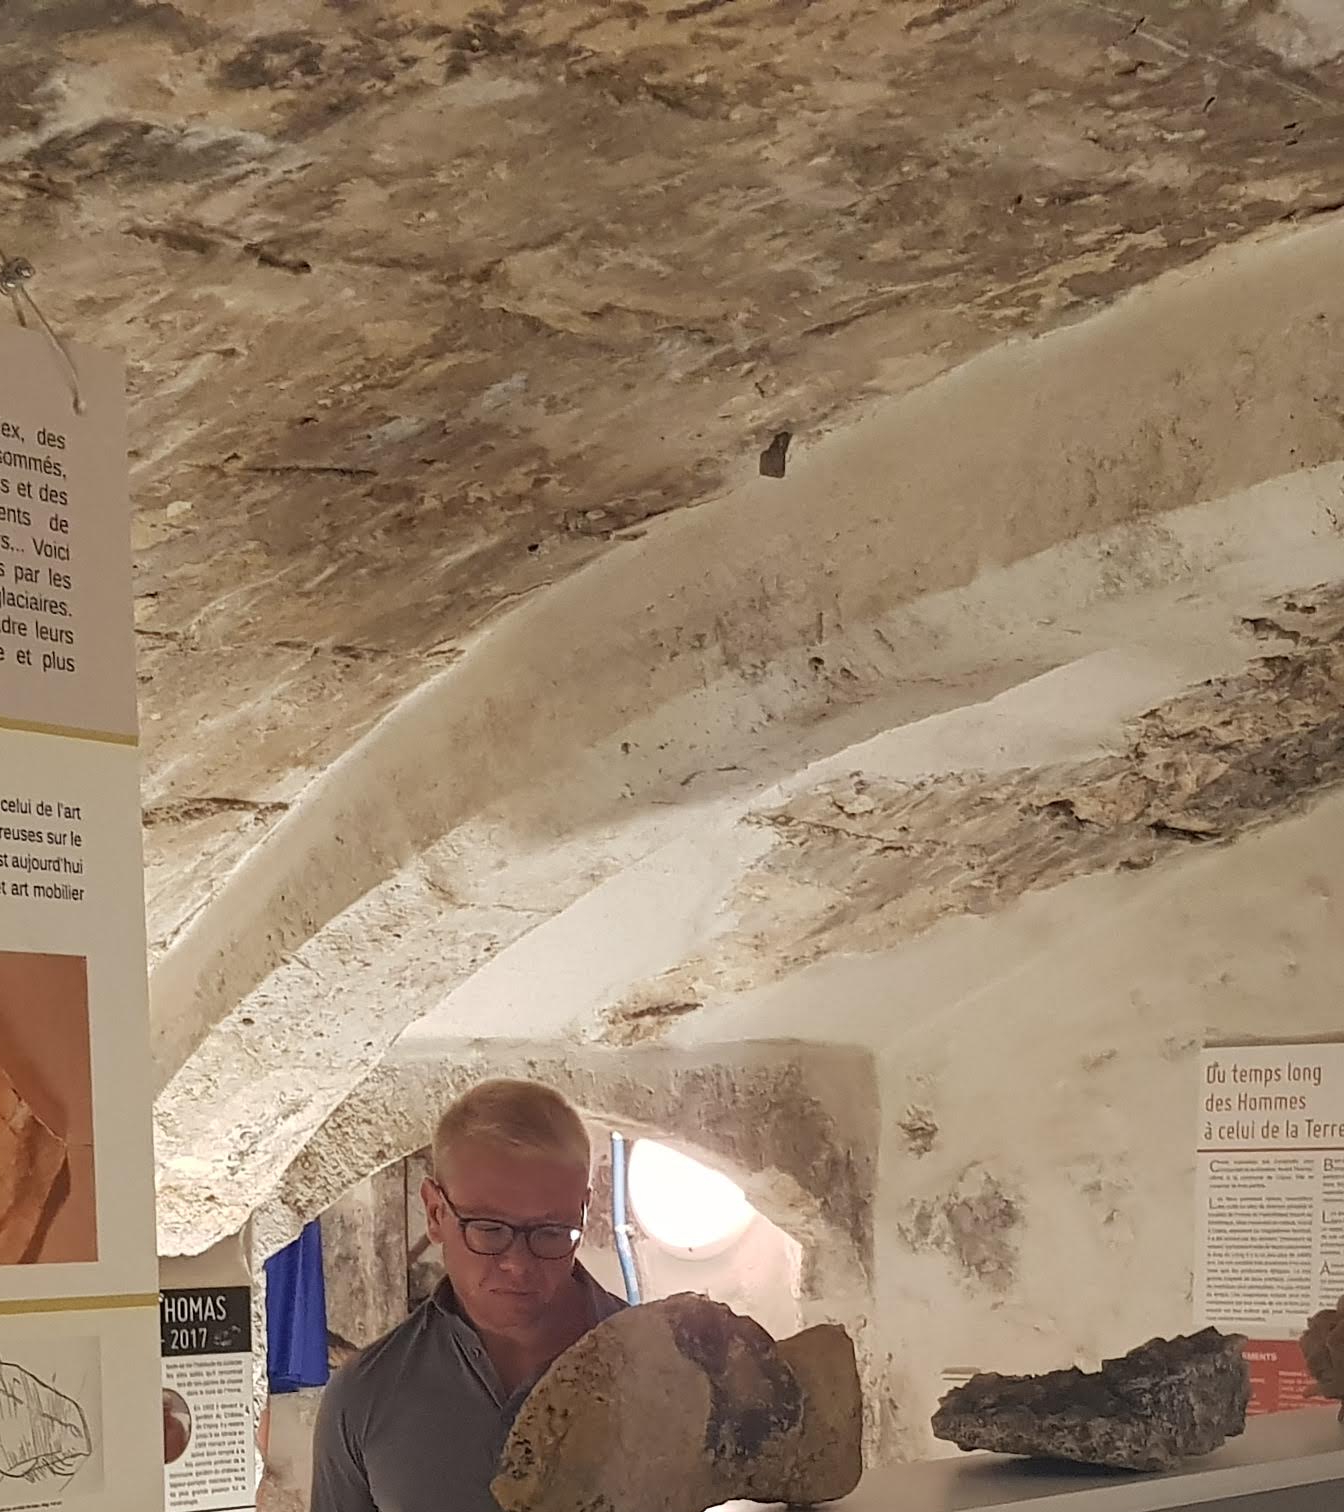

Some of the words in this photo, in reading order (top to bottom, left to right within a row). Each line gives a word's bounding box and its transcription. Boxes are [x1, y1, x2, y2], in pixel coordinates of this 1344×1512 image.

[16, 480, 34, 500] et
[38, 482, 68, 507] des
[1207, 1064, 1226, 1084] Du
[1232, 1064, 1281, 1087] temps
[1288, 1062, 1321, 1086] long
[1206, 1093, 1232, 1111] des
[1238, 1093, 1306, 1111] Hommes
[1204, 1122, 1212, 1140] à
[1219, 1120, 1255, 1139] celui
[1261, 1120, 1279, 1138] de
[1286, 1120, 1298, 1138] la
[164, 1295, 227, 1323] HOMAS
[170, 1327, 207, 1350] 2017
